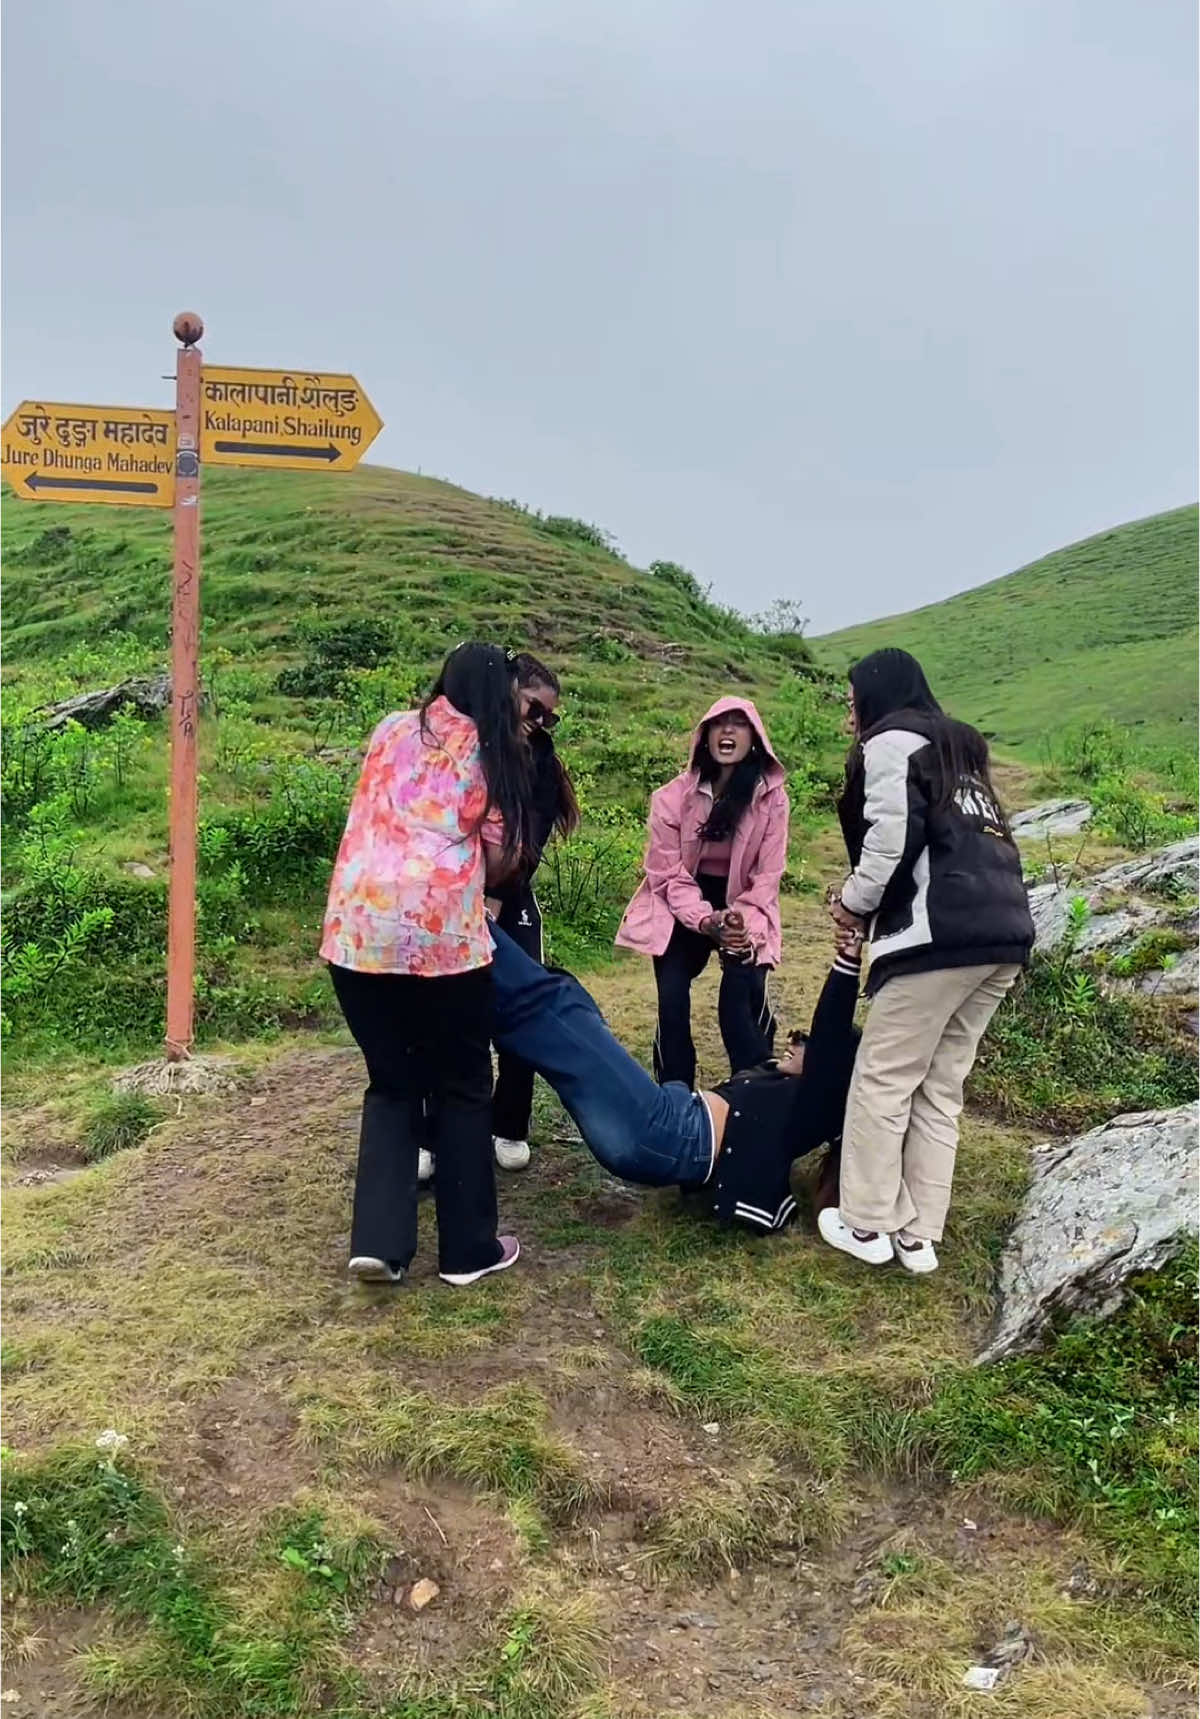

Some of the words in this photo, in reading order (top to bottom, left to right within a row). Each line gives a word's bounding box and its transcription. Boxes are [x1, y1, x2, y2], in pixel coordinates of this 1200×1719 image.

[16, 405, 52, 445] जुरे
[103, 414, 169, 448] महादेव
[1, 444, 39, 465] Jure
[43, 448, 102, 474] Dhunga
[107, 452, 173, 475] Mahadev
